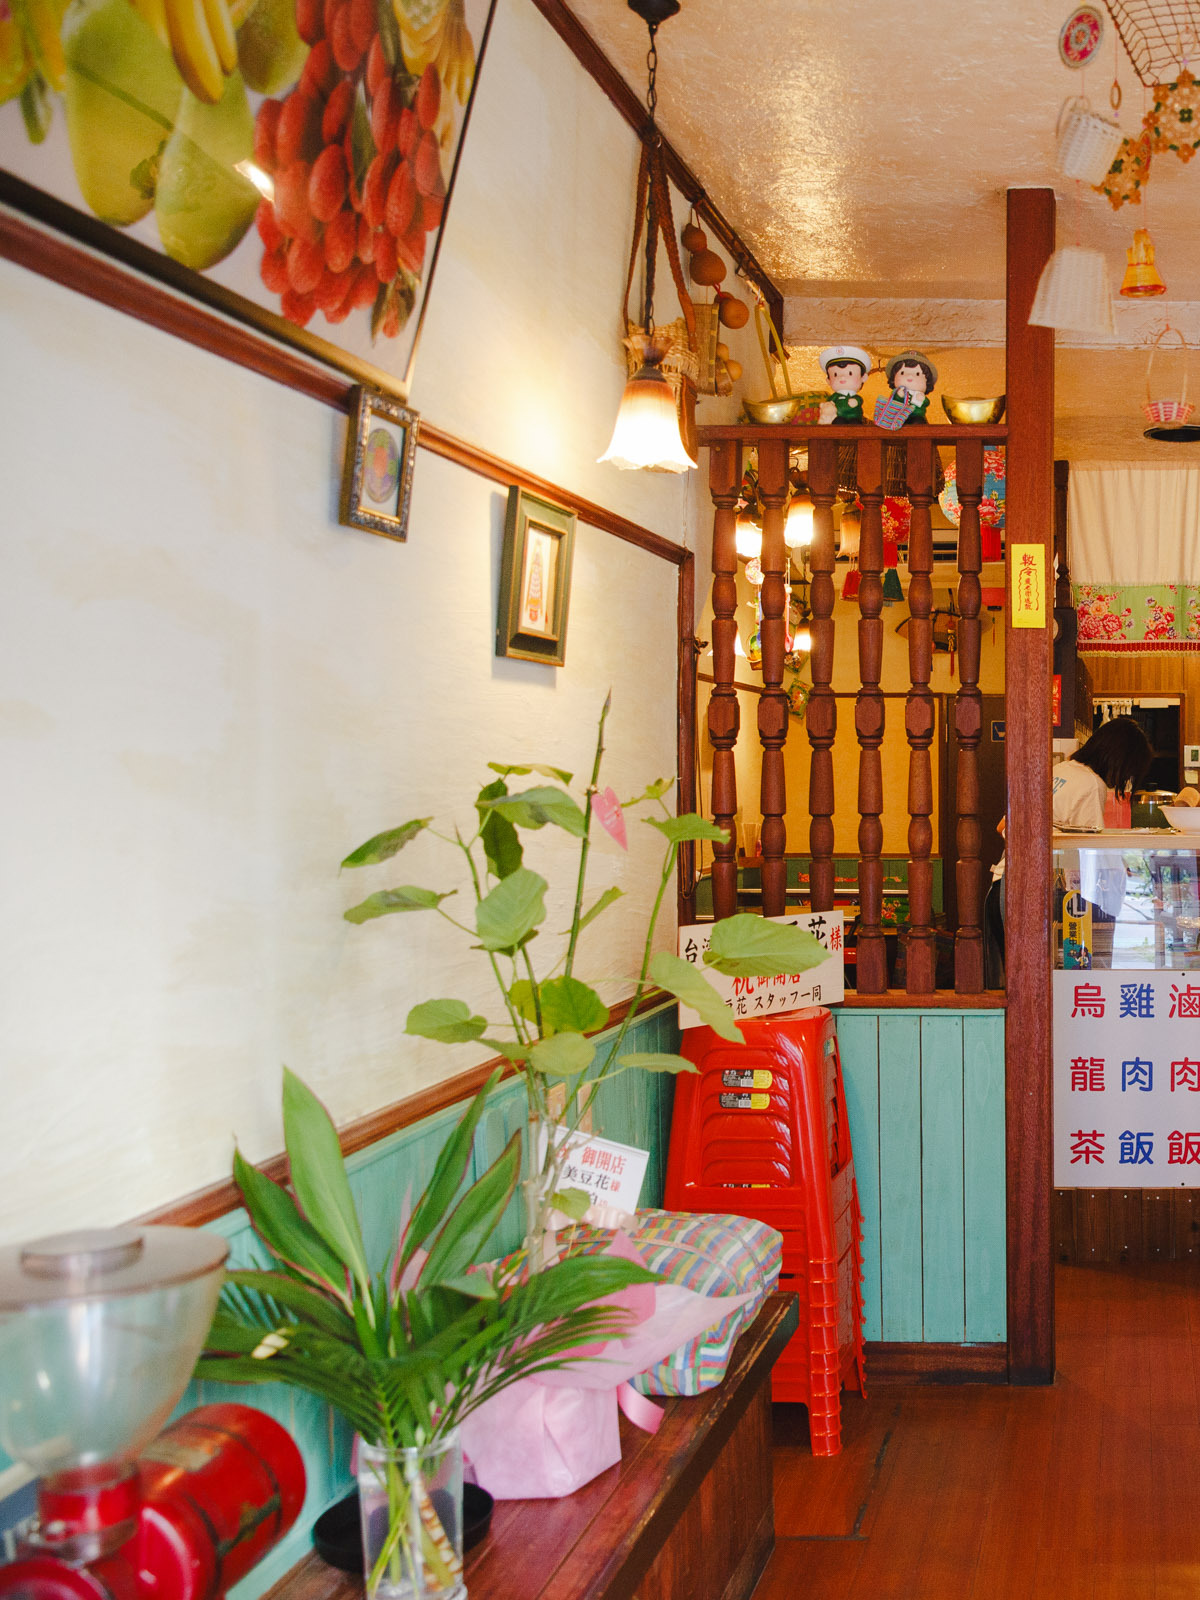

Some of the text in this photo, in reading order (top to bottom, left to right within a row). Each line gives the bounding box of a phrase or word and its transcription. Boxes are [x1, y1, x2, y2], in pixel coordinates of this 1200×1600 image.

[754, 984, 822, 1011] スタッフ一同
[581, 1146, 627, 1176] 御開店
